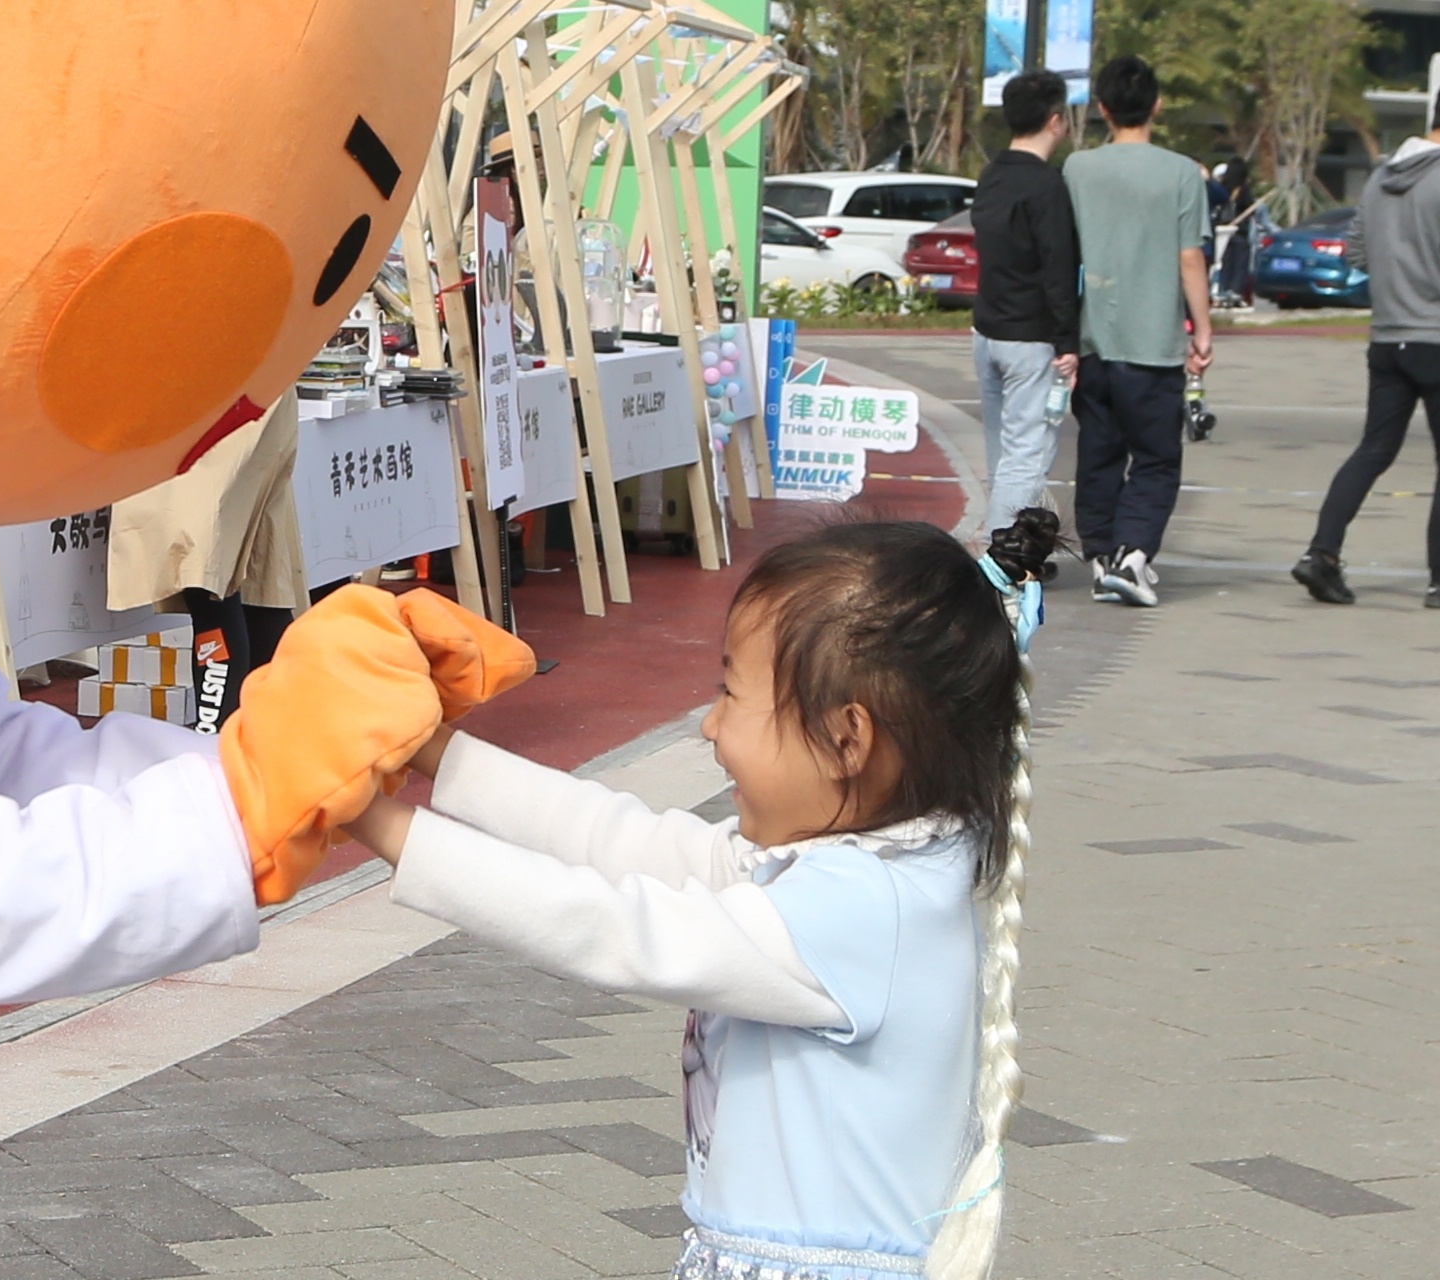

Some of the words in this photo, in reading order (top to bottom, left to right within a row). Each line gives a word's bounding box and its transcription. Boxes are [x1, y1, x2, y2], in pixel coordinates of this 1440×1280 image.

[788, 393, 908, 425] 律动横琴
[782, 423, 813, 436] THM
[818, 425, 837, 437] OF
[842, 426, 908, 442] HENGQIN
[776, 466, 853, 486] INMUK
[201, 658, 229, 707] JUST
[194, 706, 221, 736] DO
